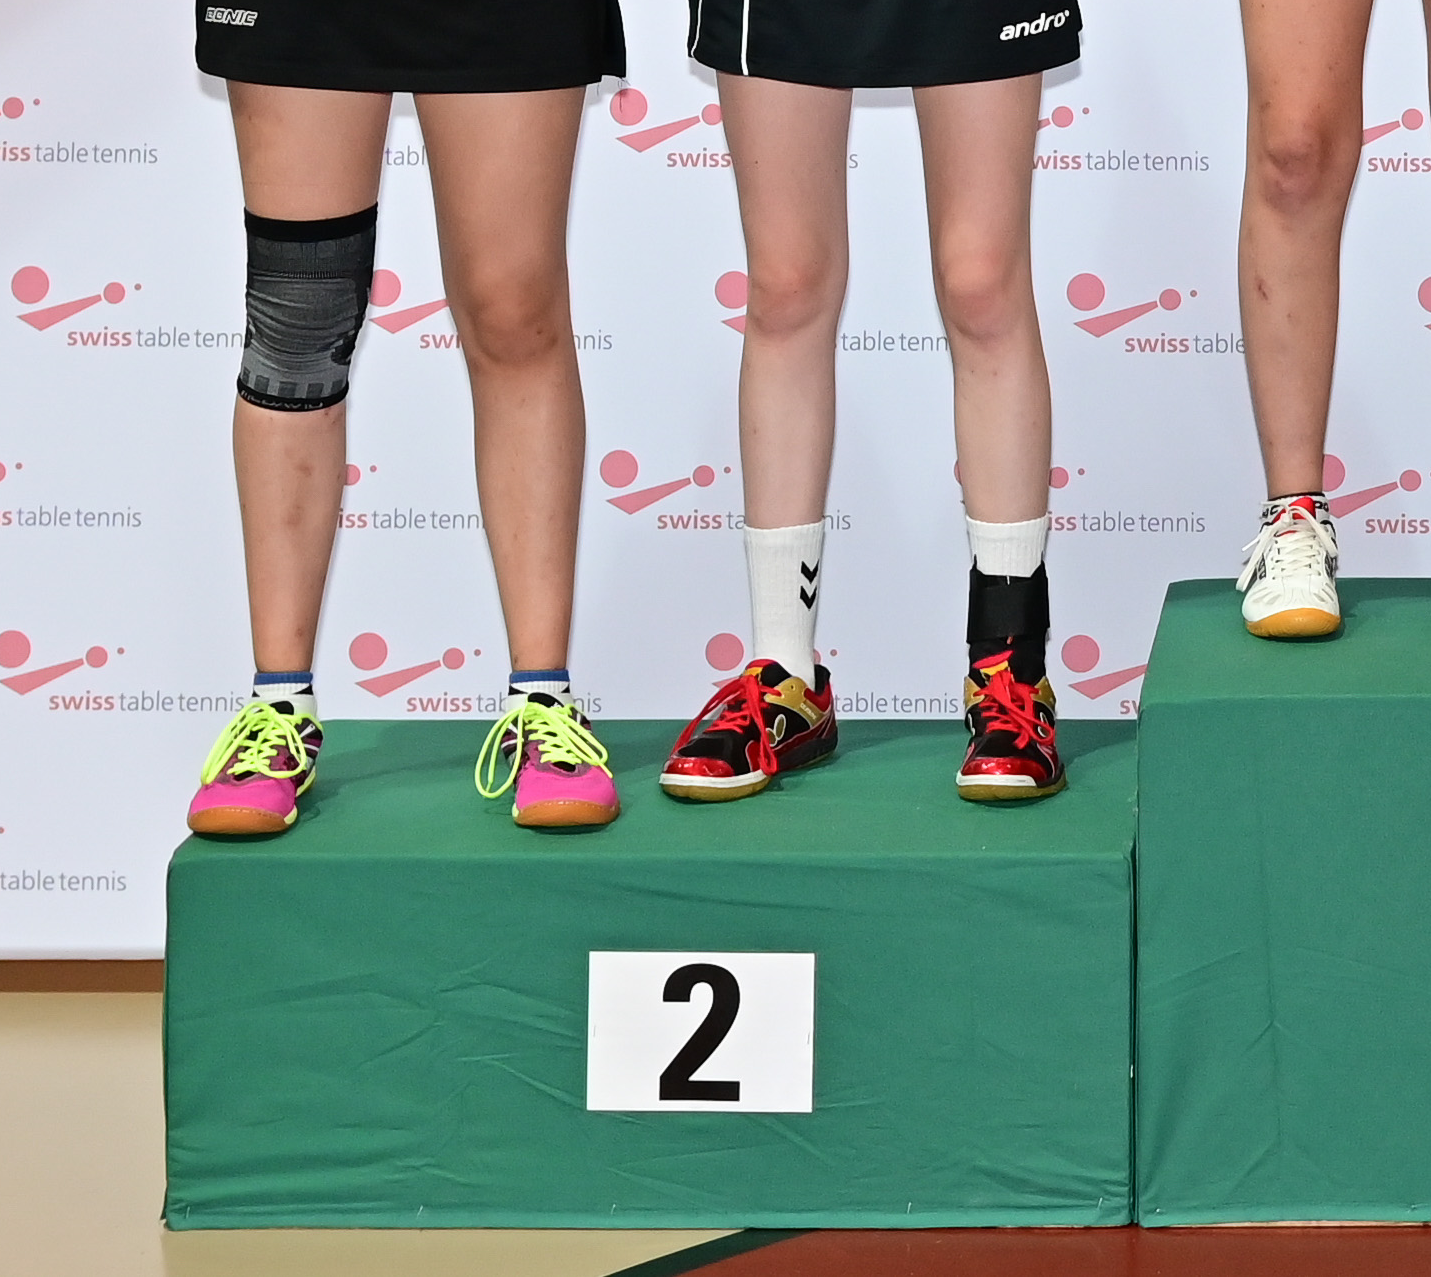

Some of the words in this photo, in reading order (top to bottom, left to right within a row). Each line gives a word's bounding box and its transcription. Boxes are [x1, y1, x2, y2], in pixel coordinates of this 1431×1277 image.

[999, 10, 1070, 41] andro
[1033, 150, 1081, 170] wiss
[659, 963, 742, 1102] 2
